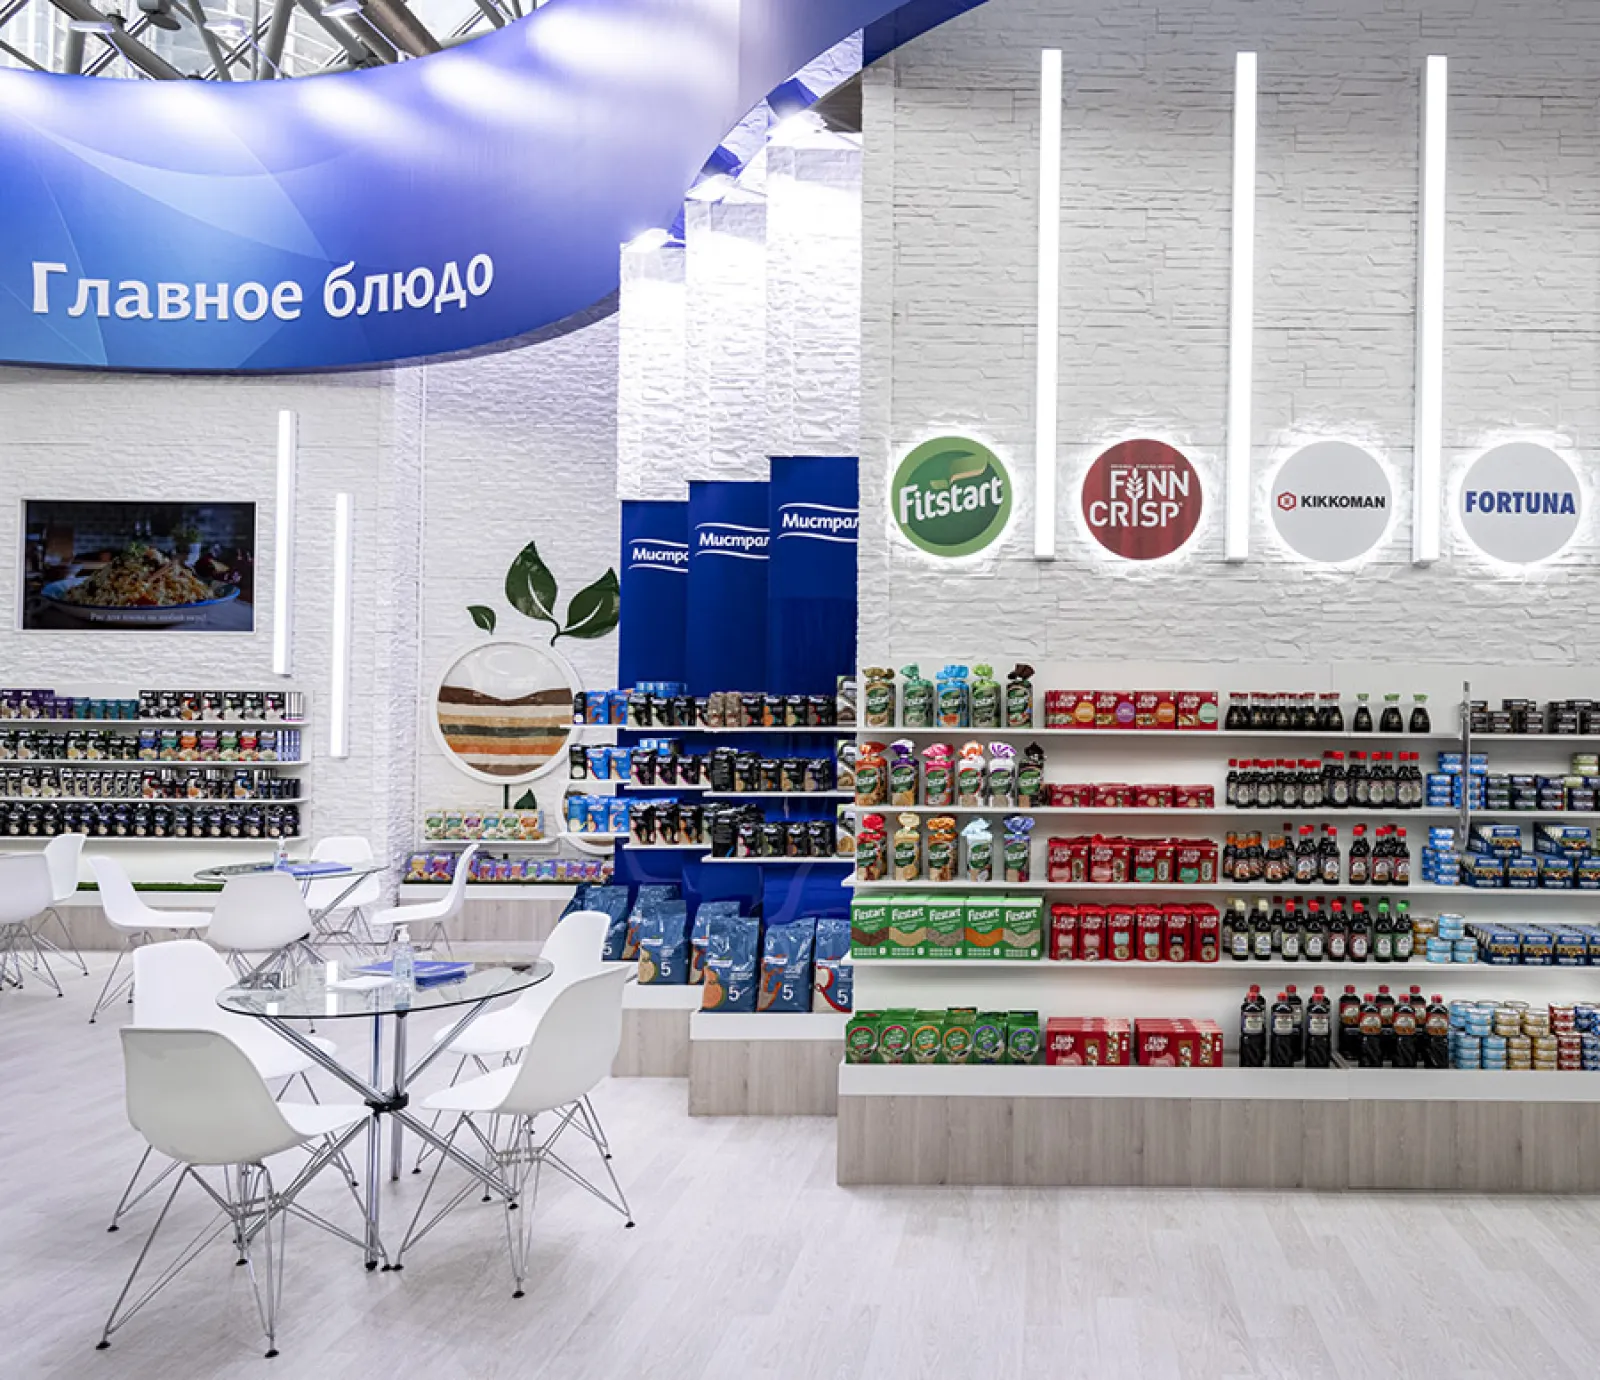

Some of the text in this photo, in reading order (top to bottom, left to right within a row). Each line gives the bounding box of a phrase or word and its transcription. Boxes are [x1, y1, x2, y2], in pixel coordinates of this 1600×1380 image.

[31, 253, 495, 321] Главное блюдо
[899, 475, 1004, 525] Fitstart
[1300, 495, 1386, 509] KIKKOMAN
[1465, 490, 1576, 515] FORTUNA
[1089, 501, 1180, 528] CRISP
[661, 961, 671, 977] 5
[728, 984, 739, 1001] 5
[782, 984, 794, 1000] 5
[837, 990, 849, 1005] 5
